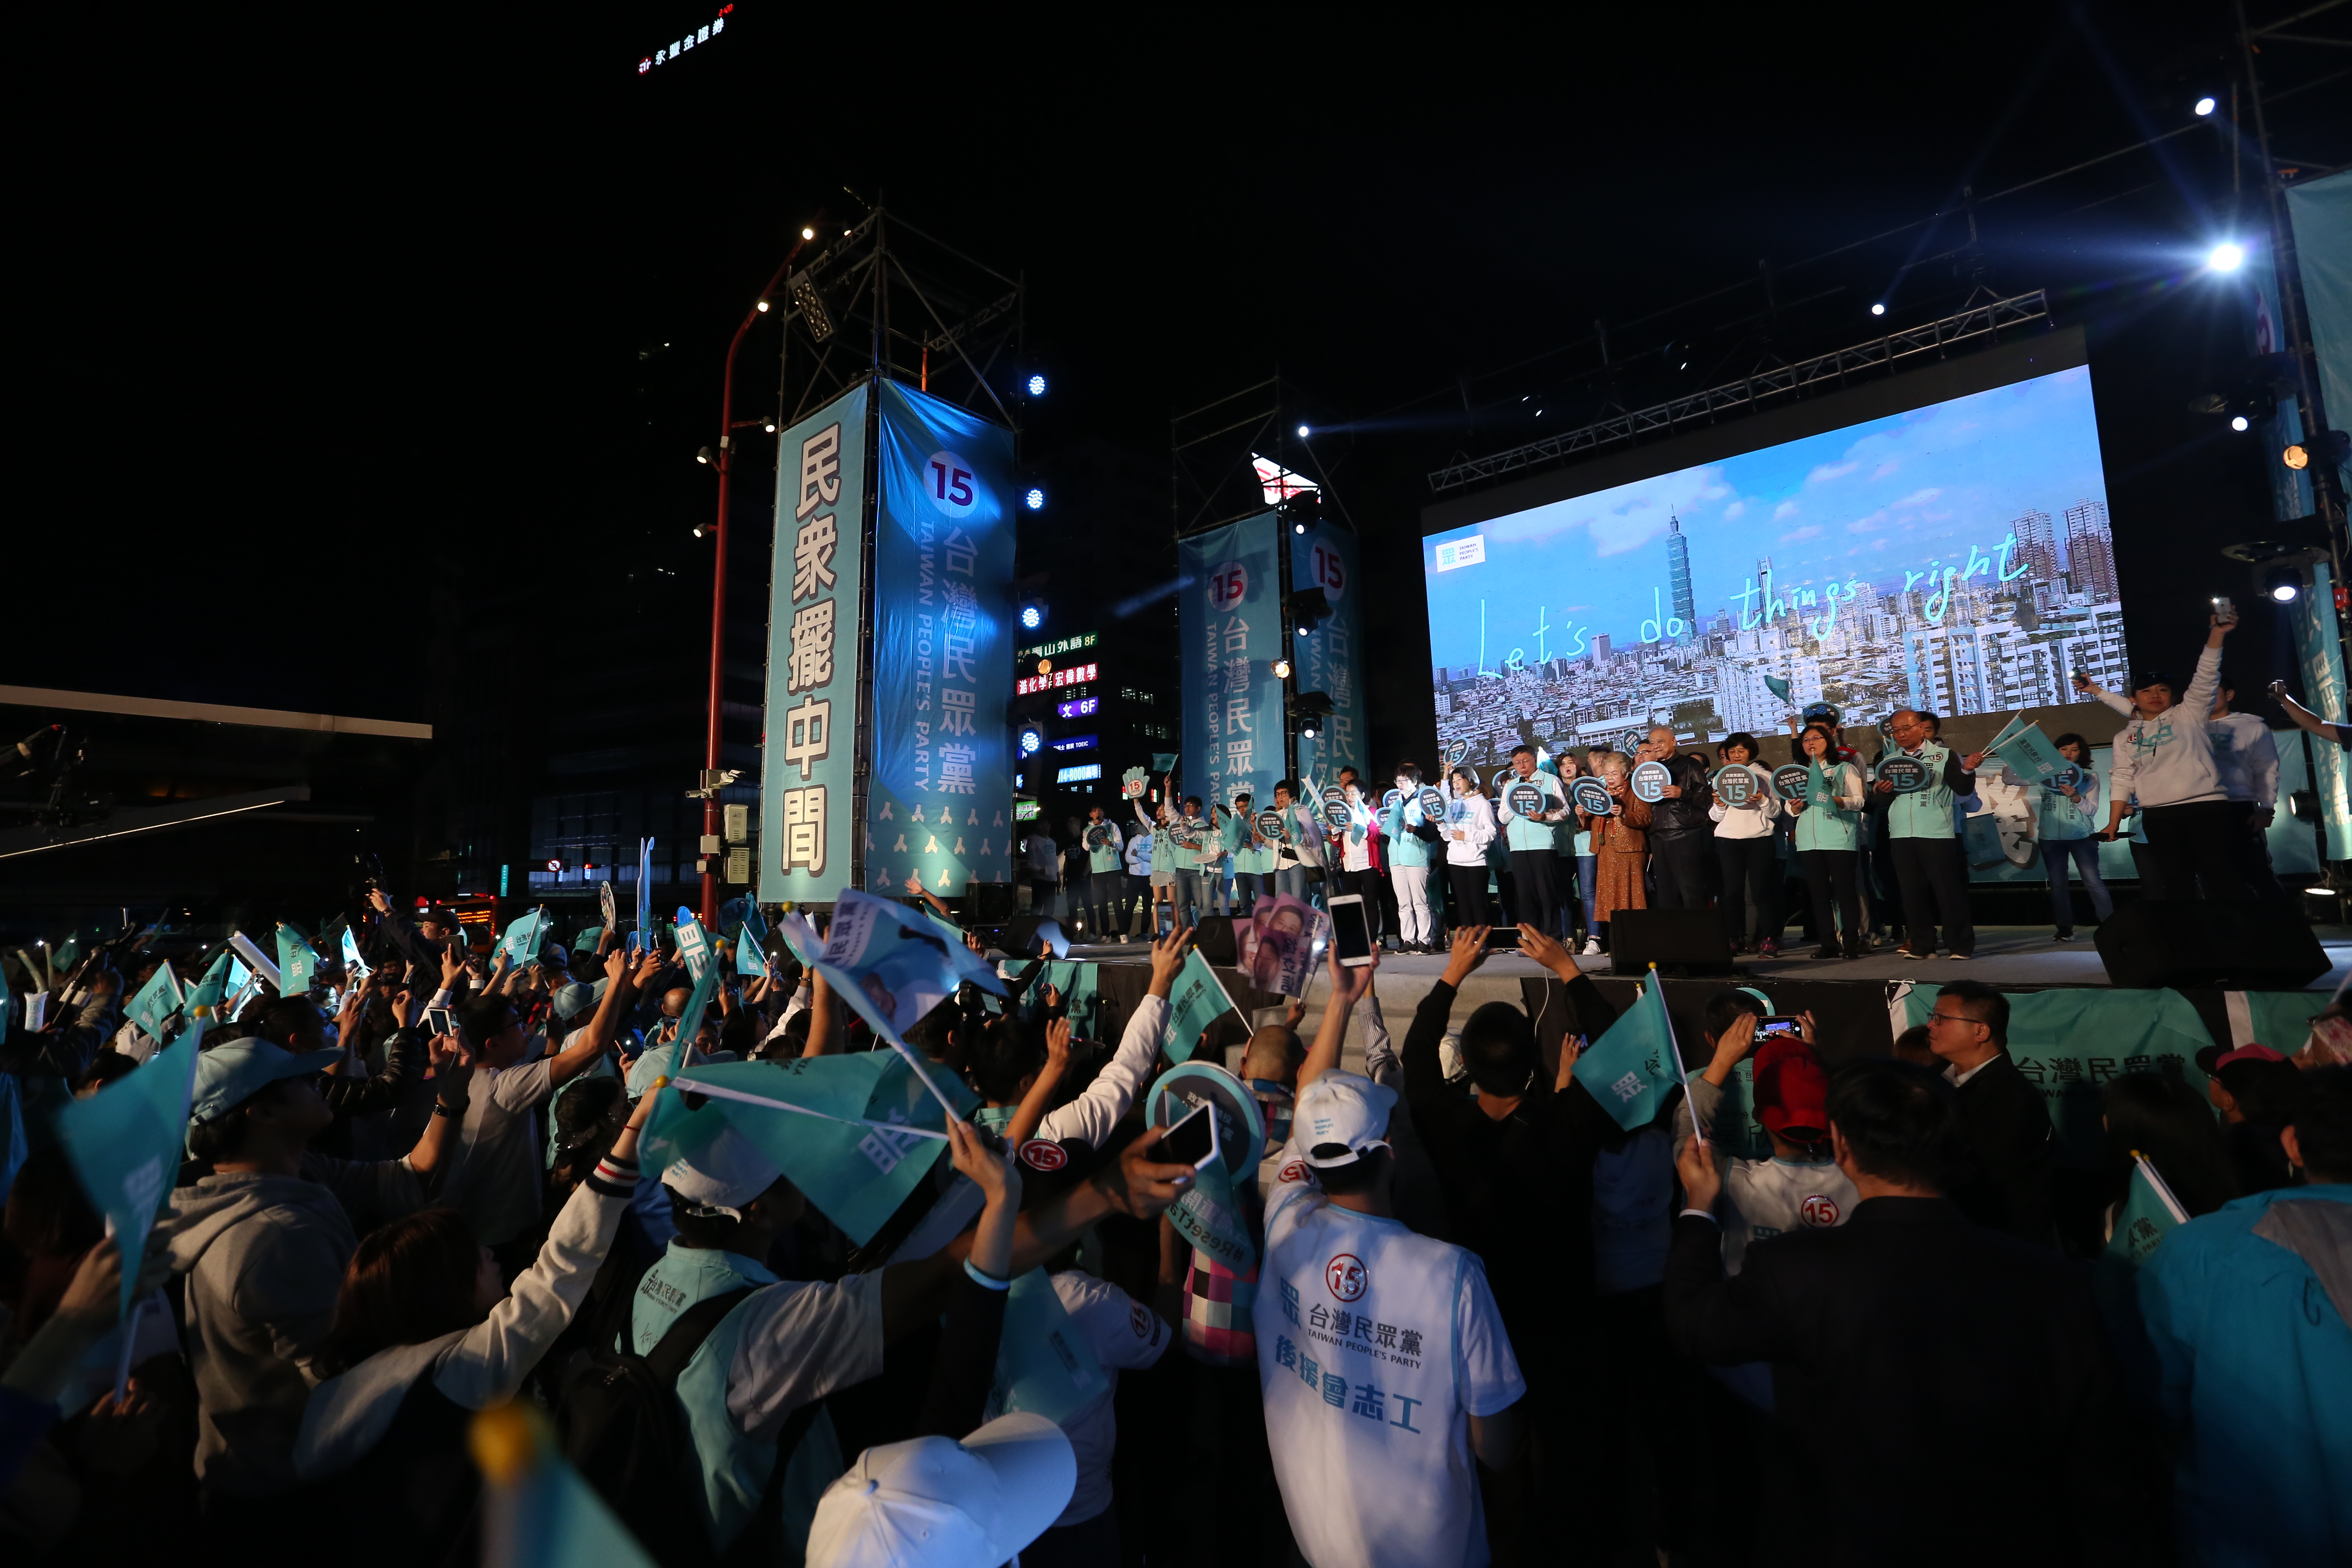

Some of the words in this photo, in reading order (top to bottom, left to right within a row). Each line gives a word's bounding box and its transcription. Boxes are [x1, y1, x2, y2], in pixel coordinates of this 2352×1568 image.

[655, 17, 724, 65] 永豐金證券
[931, 461, 973, 506] 15
[918, 520, 934, 606] TAIWAN
[1315, 547, 1344, 589] 15
[1213, 569, 1243, 603] 15
[1477, 599, 1588, 679] Let's
[1640, 586, 1683, 644] do
[1730, 570, 1858, 641] things
[1904, 532, 2028, 621] right
[1032, 636, 1082, 657] 青山外語
[1085, 635, 1096, 646] 8F
[1206, 622, 1218, 686] TAIWAN
[916, 613, 933, 711] PEOPLE'S
[937, 526, 979, 795] 台灣民眾黨
[1055, 664, 1096, 687] 宏偉數學
[1080, 699, 1096, 714] 6F
[1208, 693, 1220, 764] PEOPLE'S
[914, 721, 929, 791] PARTY
[1450, 751, 1461, 761] 15
[1129, 782, 1140, 791] 15
[1642, 782, 1662, 796] 15
[1779, 775, 1808, 786] 台灣民眾黨
[1785, 782, 1808, 797] 15
[1889, 774, 1915, 786] 15
[2050, 775, 2071, 787] 15
[1725, 785, 1746, 800] 15
[1426, 803, 1443, 816] 15
[1584, 798, 1604, 811] 15
[1331, 814, 1347, 825] 15
[1264, 826, 1281, 836] 15
[1030, 1147, 1058, 1165] 15
[1804, 1203, 1835, 1224] 15
[1328, 1262, 1361, 1295] 15
[1308, 1303, 1423, 1356] 台灣民眾黨
[1307, 1328, 1343, 1347] TAIWAN
[1345, 1340, 1388, 1361] PEOPLE'S
[1390, 1354, 1422, 1369] PARTY
[1274, 1333, 1422, 1434] 後援會志工
